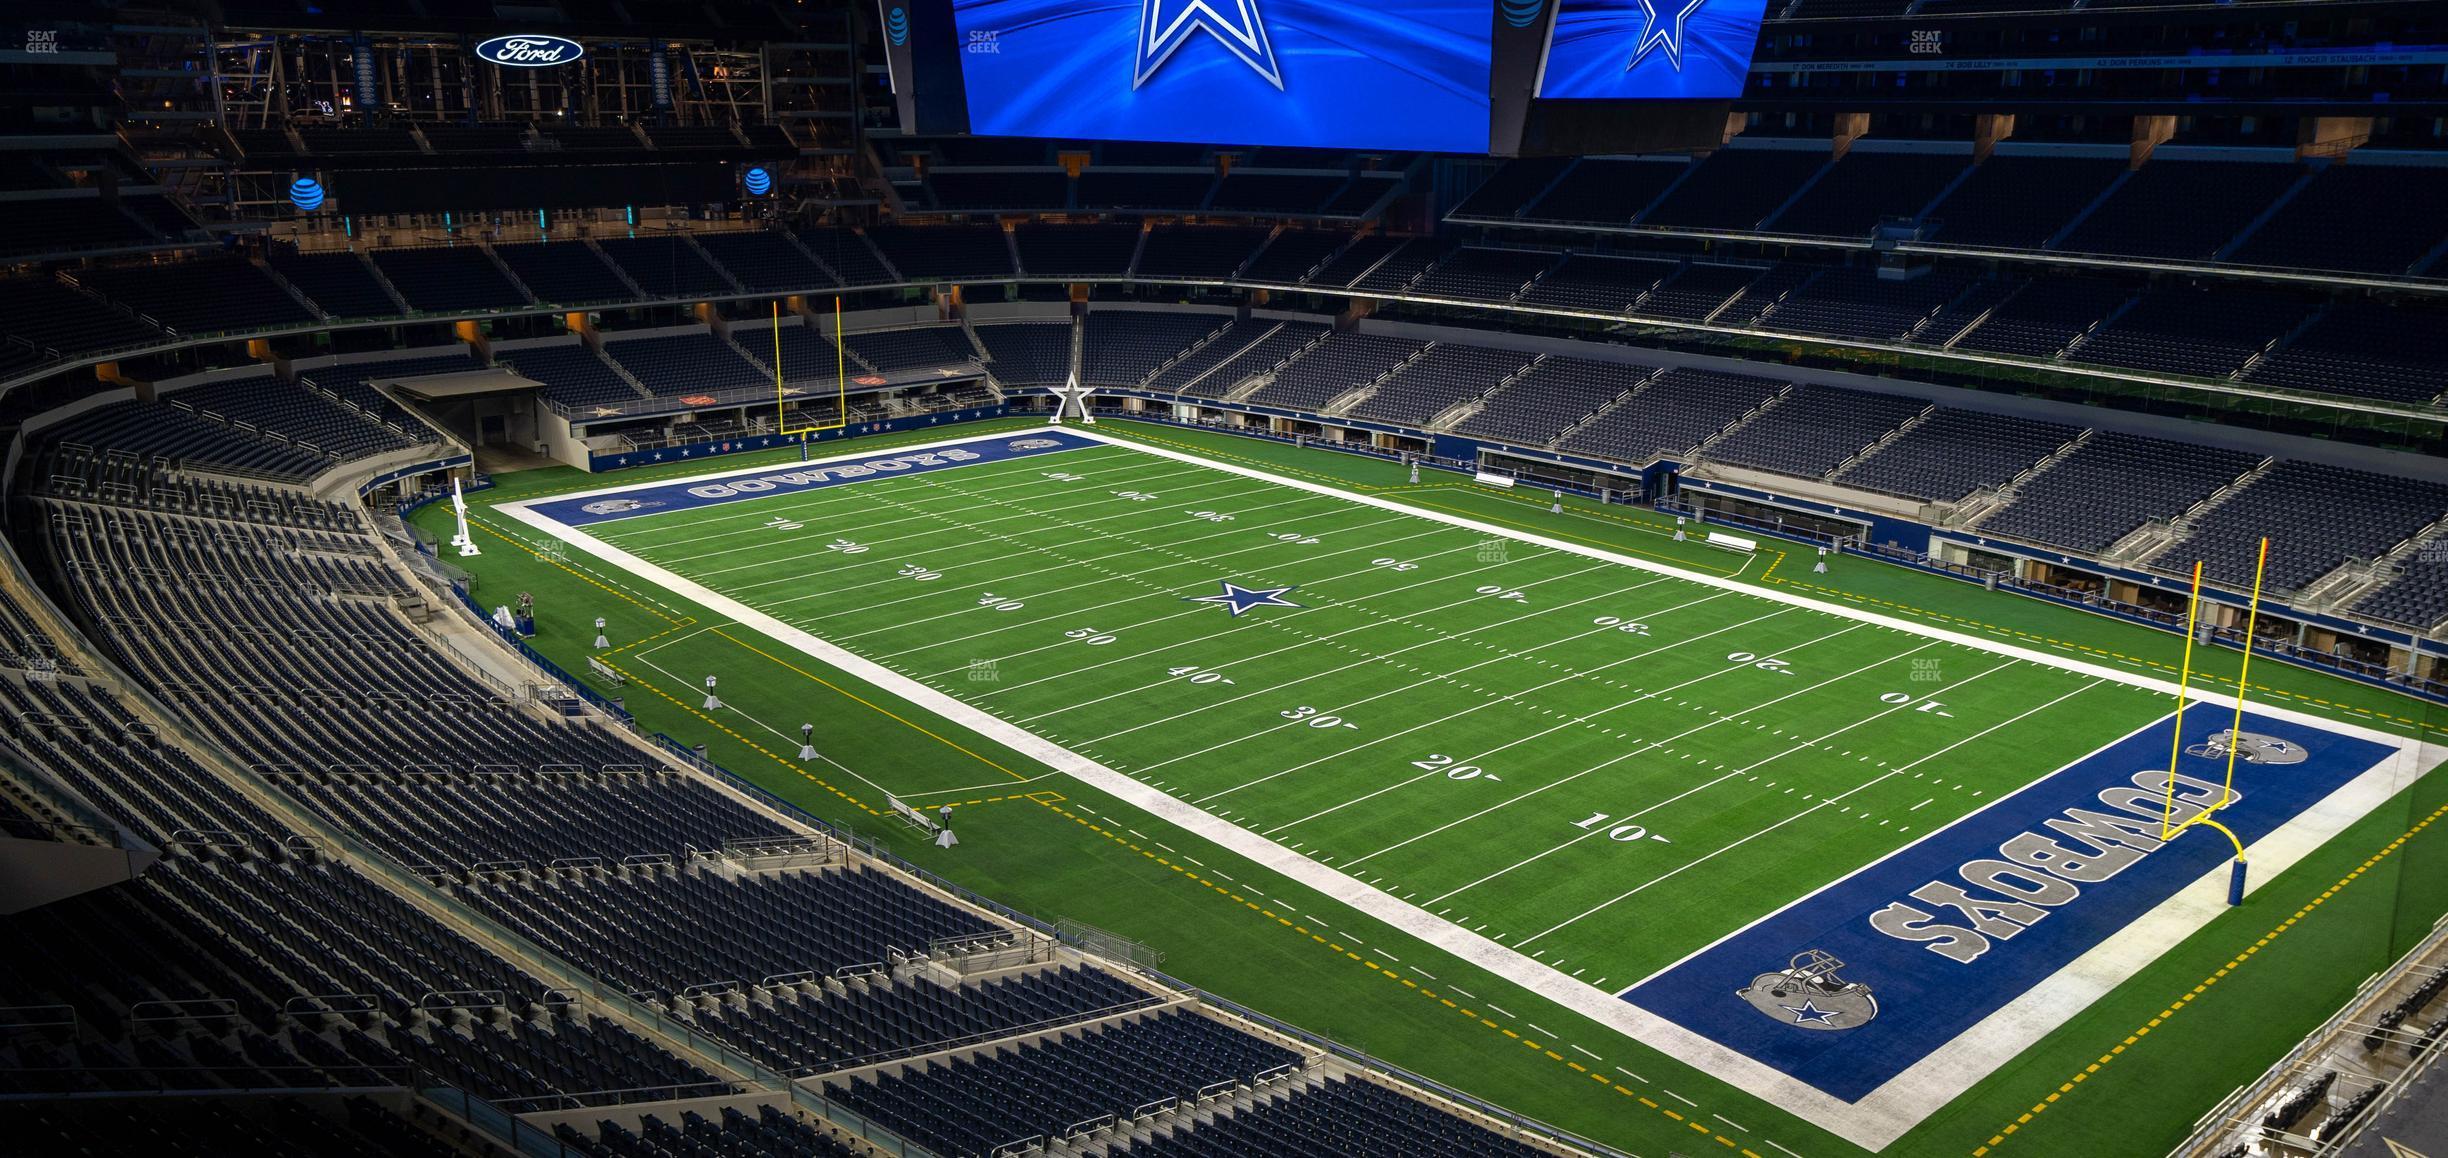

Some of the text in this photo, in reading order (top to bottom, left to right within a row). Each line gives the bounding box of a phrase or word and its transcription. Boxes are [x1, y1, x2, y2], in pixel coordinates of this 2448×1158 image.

[496, 39, 564, 61] Ford
[2298, 56, 2328, 64] ROGER
[2329, 55, 2377, 64] STAUBACH
[688, 449, 981, 499] COWBOYS
[1047, 472, 1086, 482] 10
[1117, 490, 1159, 501] 20
[764, 518, 804, 531] 10
[1193, 510, 1235, 522] 30
[825, 539, 870, 554] 20
[1277, 532, 1321, 545] 40
[897, 564, 943, 581] 30
[1371, 557, 1419, 572] 50
[1476, 584, 1527, 601] 40
[977, 595, 1025, 611] 40
[1593, 616, 1649, 633] 30
[1064, 627, 1117, 646] 50
[1727, 652, 1792, 672] 20
[1166, 665, 1223, 684] 40
[1879, 692, 1946, 715] 10
[1279, 705, 1343, 730] 30
[1410, 753, 1483, 782] 20
[1569, 810, 1648, 843] 10
[1869, 770, 2242, 964] COWBOYS
